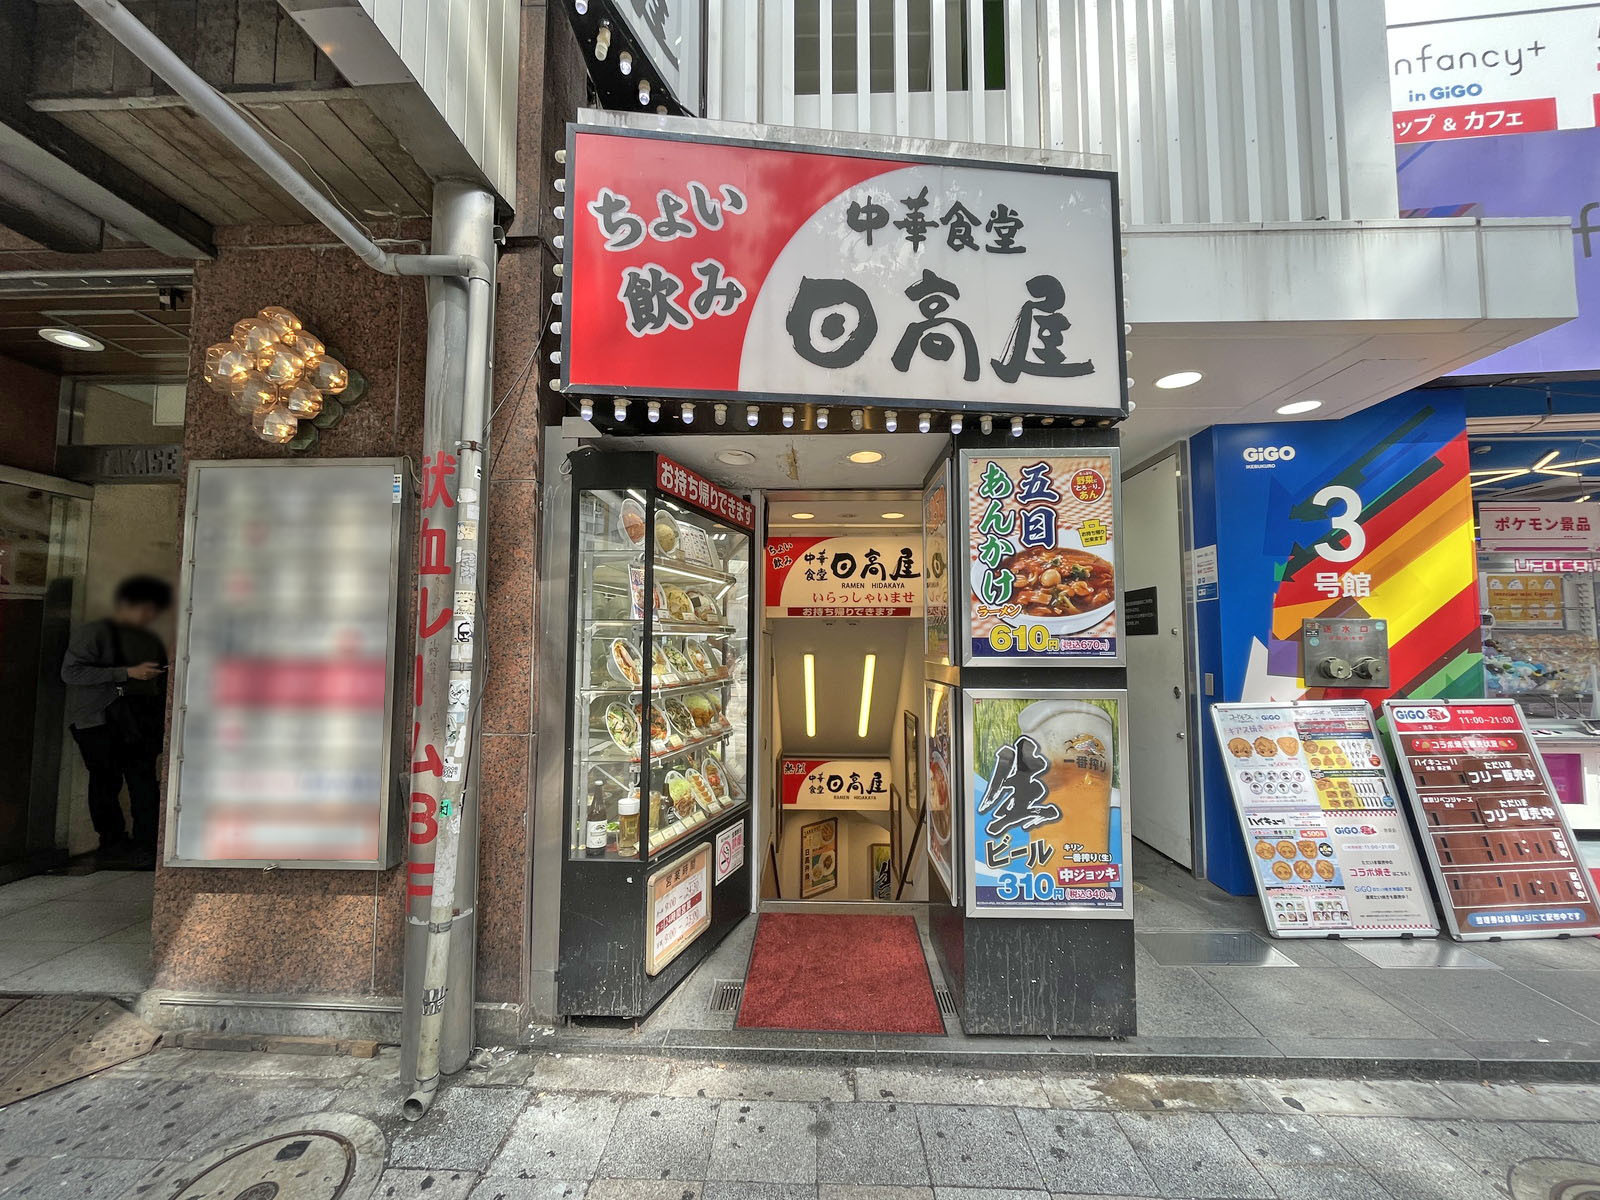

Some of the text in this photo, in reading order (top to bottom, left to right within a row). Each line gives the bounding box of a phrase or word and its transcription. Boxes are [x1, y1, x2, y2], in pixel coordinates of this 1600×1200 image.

[1408, 83, 1483, 102] in GiGO
[1442, 117, 1457, 132] &
[1464, 110, 1524, 131] カフェ
[592, 182, 746, 250] ちょい
[846, 185, 1028, 255] 中華食堂
[622, 260, 746, 336] 飲み
[785, 267, 1096, 384] 日高屋
[1242, 445, 1296, 462] GiGO
[660, 461, 753, 526] お持ち帰りできます
[1080, 490, 1099, 500] あん
[1016, 461, 1060, 549] 五目
[1312, 485, 1367, 562] 3
[1495, 516, 1591, 532] ポケモン景品
[978, 461, 1015, 605] あんかけ
[831, 547, 921, 582] 日高屋
[1313, 571, 1372, 599] 号館
[812, 591, 915, 604] いらっしゃいませ
[802, 607, 896, 617] お持ち帰りできます
[976, 604, 1023, 619] ラーメン
[1396, 710, 1425, 720] GiGO
[1063, 755, 1107, 773] 一番搾り
[1483, 760, 1512, 769] ただいま
[826, 771, 888, 795] 日高屋
[1467, 768, 1536, 784] フリー販売中
[979, 736, 1061, 835] 生
[1498, 798, 1529, 808] ただいま
[1483, 806, 1556, 823] フリー販売中
[1334, 826, 1359, 835] GiGO
[985, 834, 1055, 869] ビール
[1063, 843, 1084, 852] キリン
[1059, 867, 1117, 882] 中ジョッキ
[1349, 868, 1392, 877] コラボ焼き
[996, 871, 1064, 901] 310円
